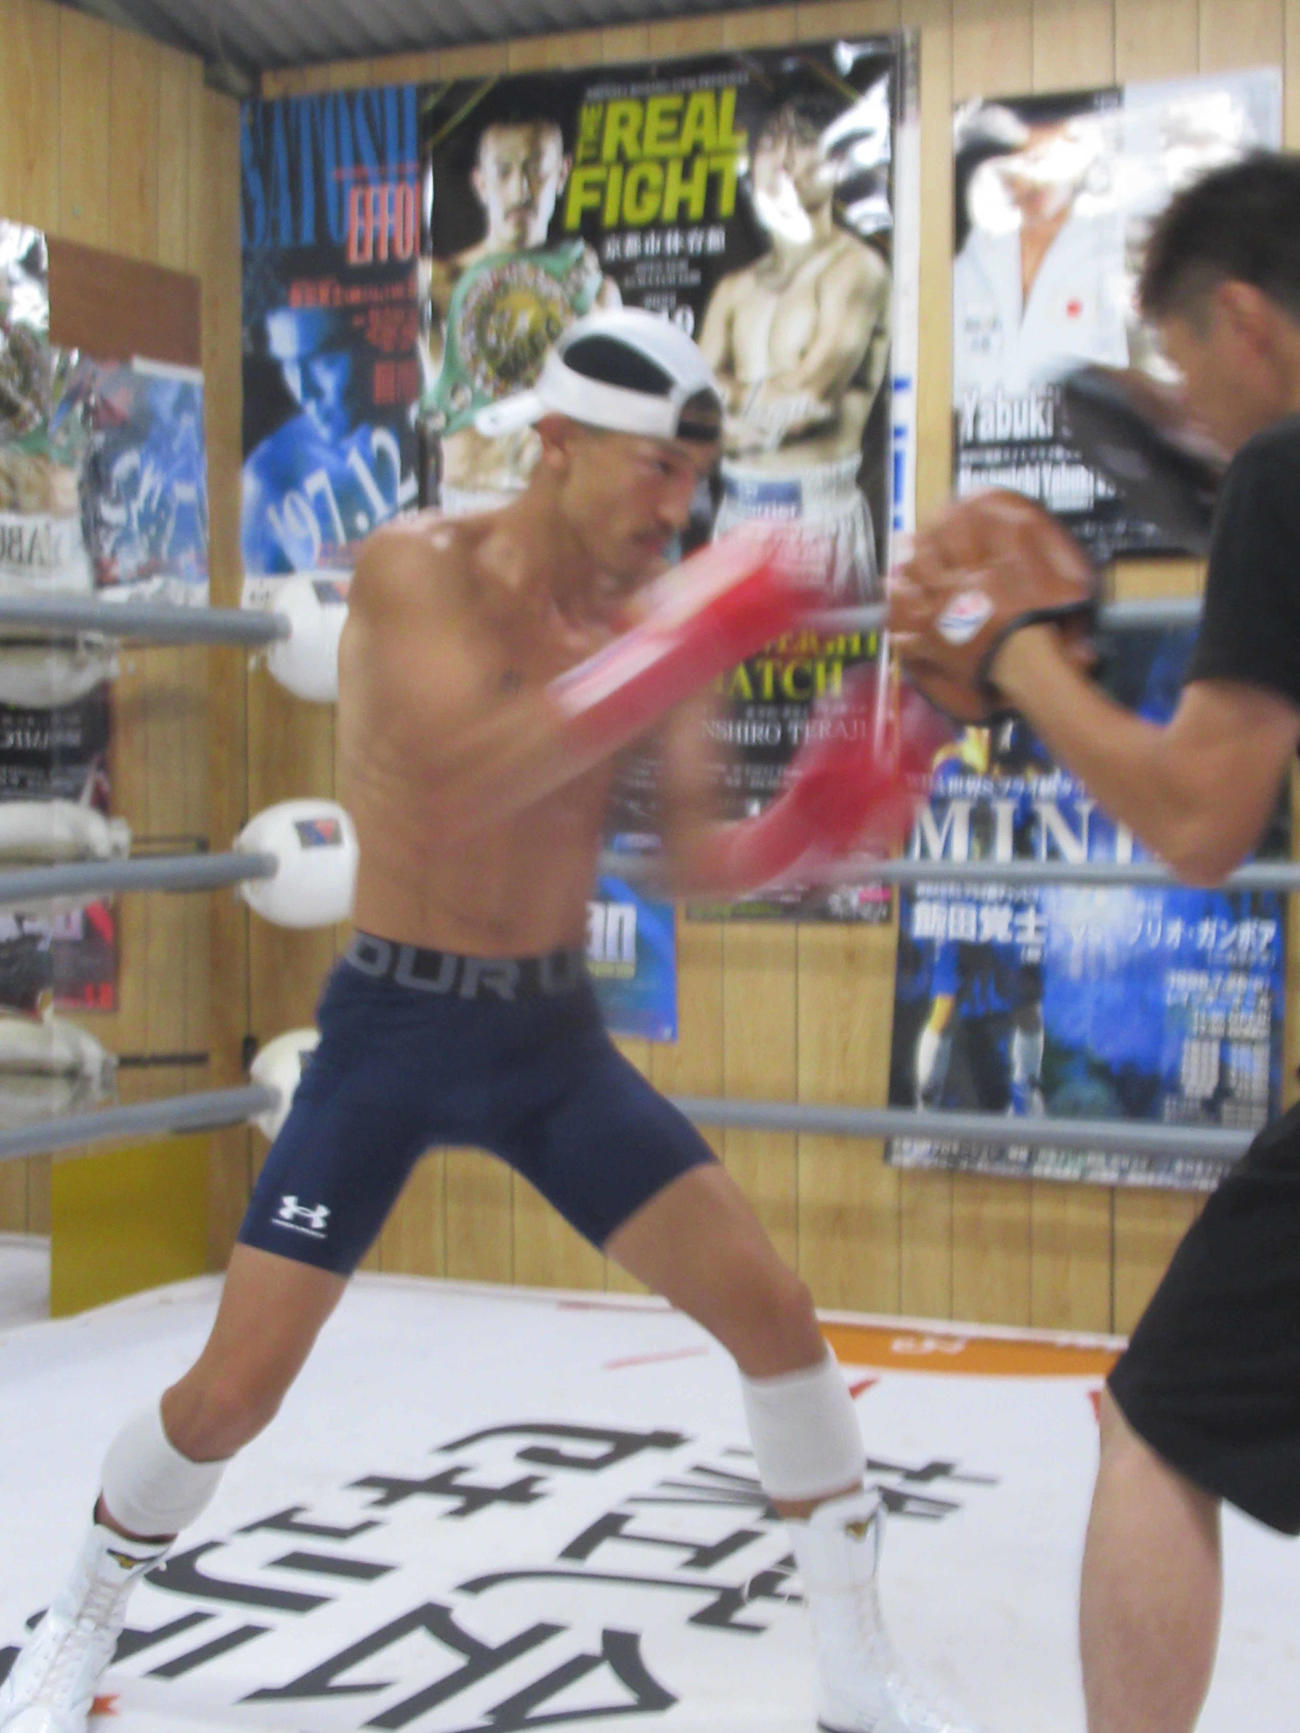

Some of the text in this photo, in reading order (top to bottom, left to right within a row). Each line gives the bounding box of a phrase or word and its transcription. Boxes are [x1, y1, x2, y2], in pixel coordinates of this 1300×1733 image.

[602, 87, 748, 161] REAL
[563, 154, 739, 232] FIGHT
[961, 386, 1055, 443] Yabuki
